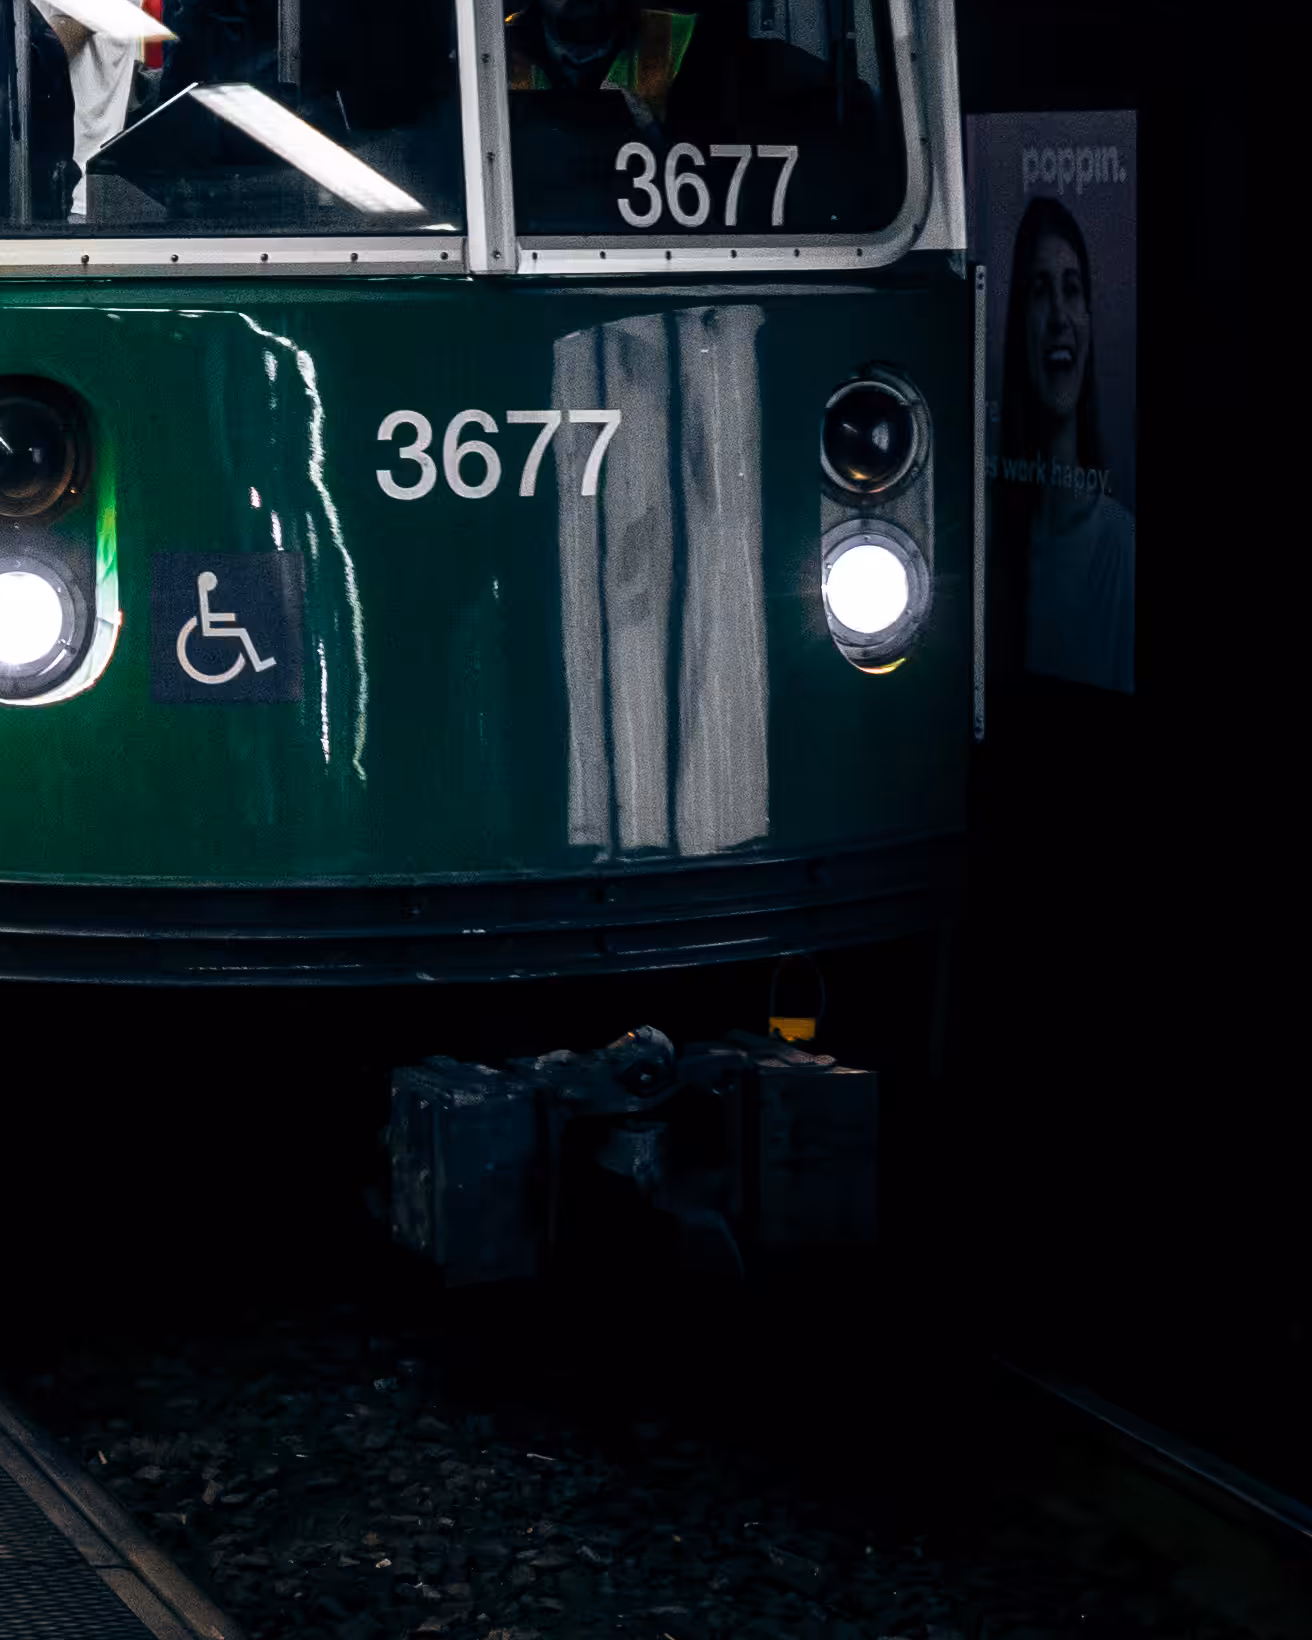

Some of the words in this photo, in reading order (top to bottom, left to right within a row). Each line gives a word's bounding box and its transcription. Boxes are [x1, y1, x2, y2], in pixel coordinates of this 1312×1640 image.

[615, 142, 799, 228] 3677
[1022, 145, 1127, 196] poppin.
[375, 409, 622, 501] 3677
[1002, 449, 1046, 486] work
